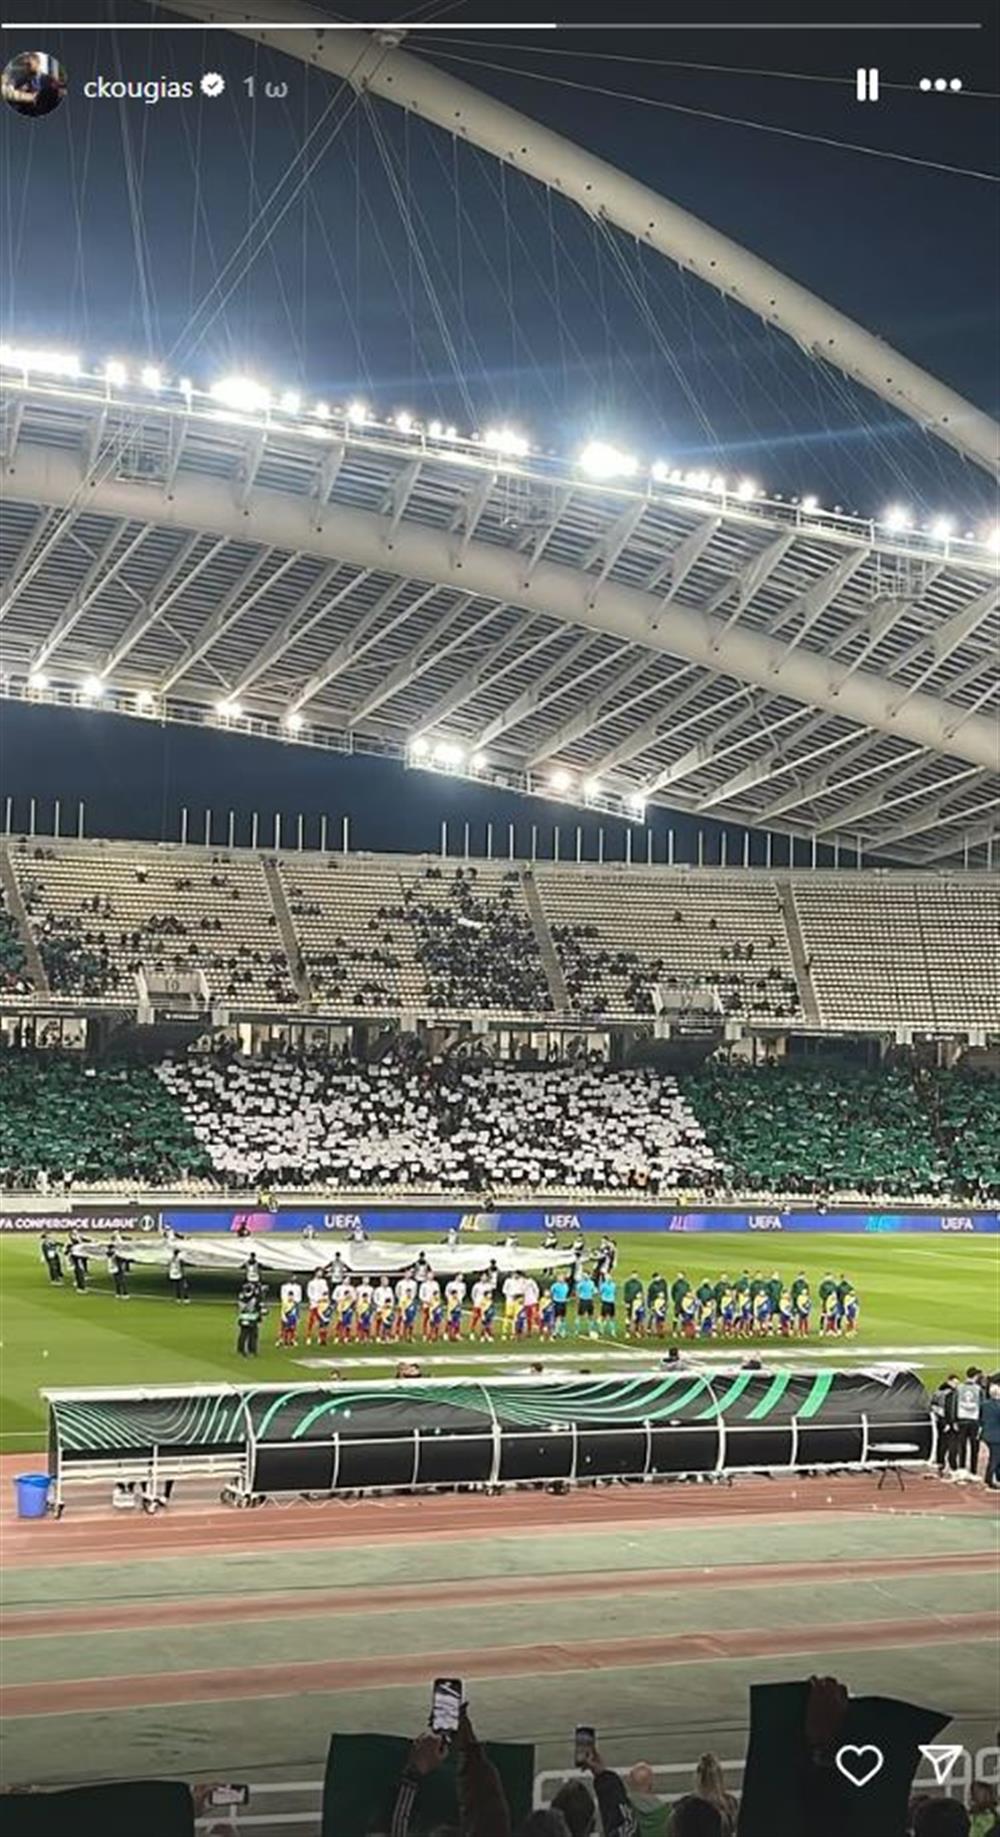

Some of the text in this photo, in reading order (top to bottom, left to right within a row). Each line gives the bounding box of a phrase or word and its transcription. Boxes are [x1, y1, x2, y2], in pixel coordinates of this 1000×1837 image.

[91, 1217, 134, 1229] LEAGUE
[323, 1214, 363, 1228] UEFA
[543, 1214, 581, 1229] UEFA
[748, 1215, 783, 1229] UEFA
[940, 1217, 974, 1230] UEFA
